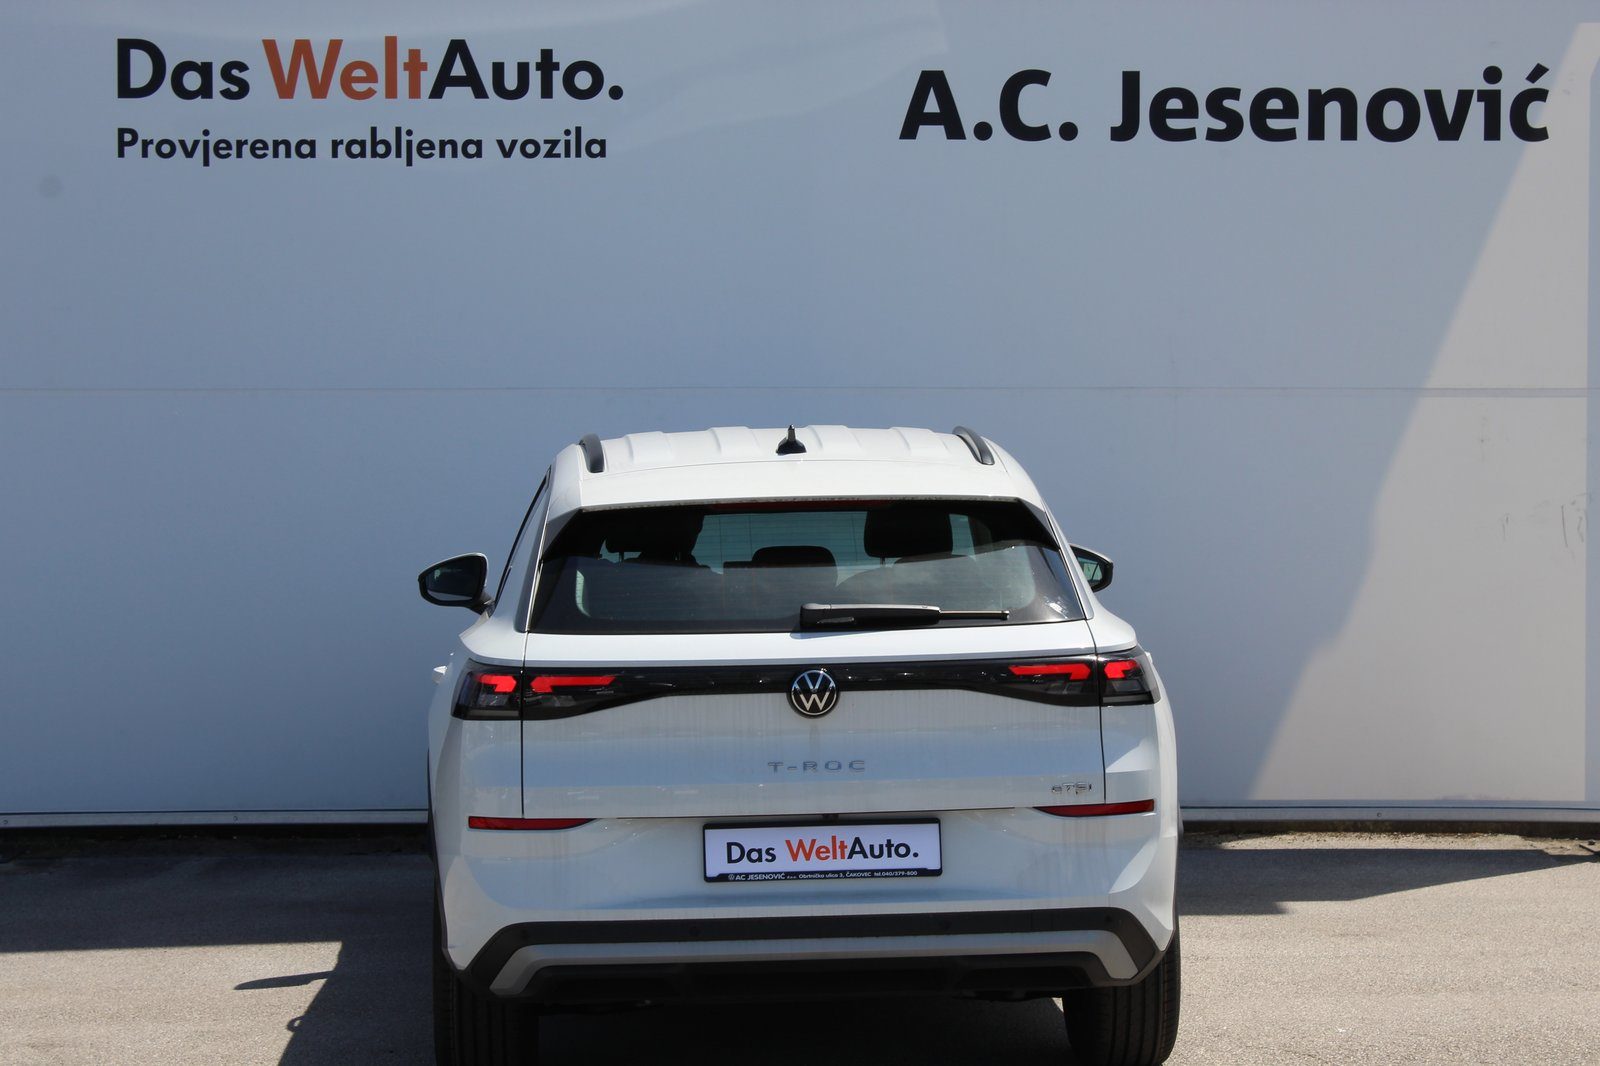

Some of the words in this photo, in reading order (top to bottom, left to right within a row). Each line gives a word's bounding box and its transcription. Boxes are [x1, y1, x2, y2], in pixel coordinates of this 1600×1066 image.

[116, 38, 251, 101] Das
[262, 36, 624, 101] WeltAuto.
[898, 68, 1079, 142] A.C.
[1110, 62, 1551, 143] Jesenović
[116, 126, 317, 168] Provjerena
[331, 126, 484, 167] rabljena
[496, 127, 608, 160] vozila
[767, 760, 866, 773] T-ROC
[726, 842, 777, 864] Das
[785, 835, 919, 862] WeltAuto.
